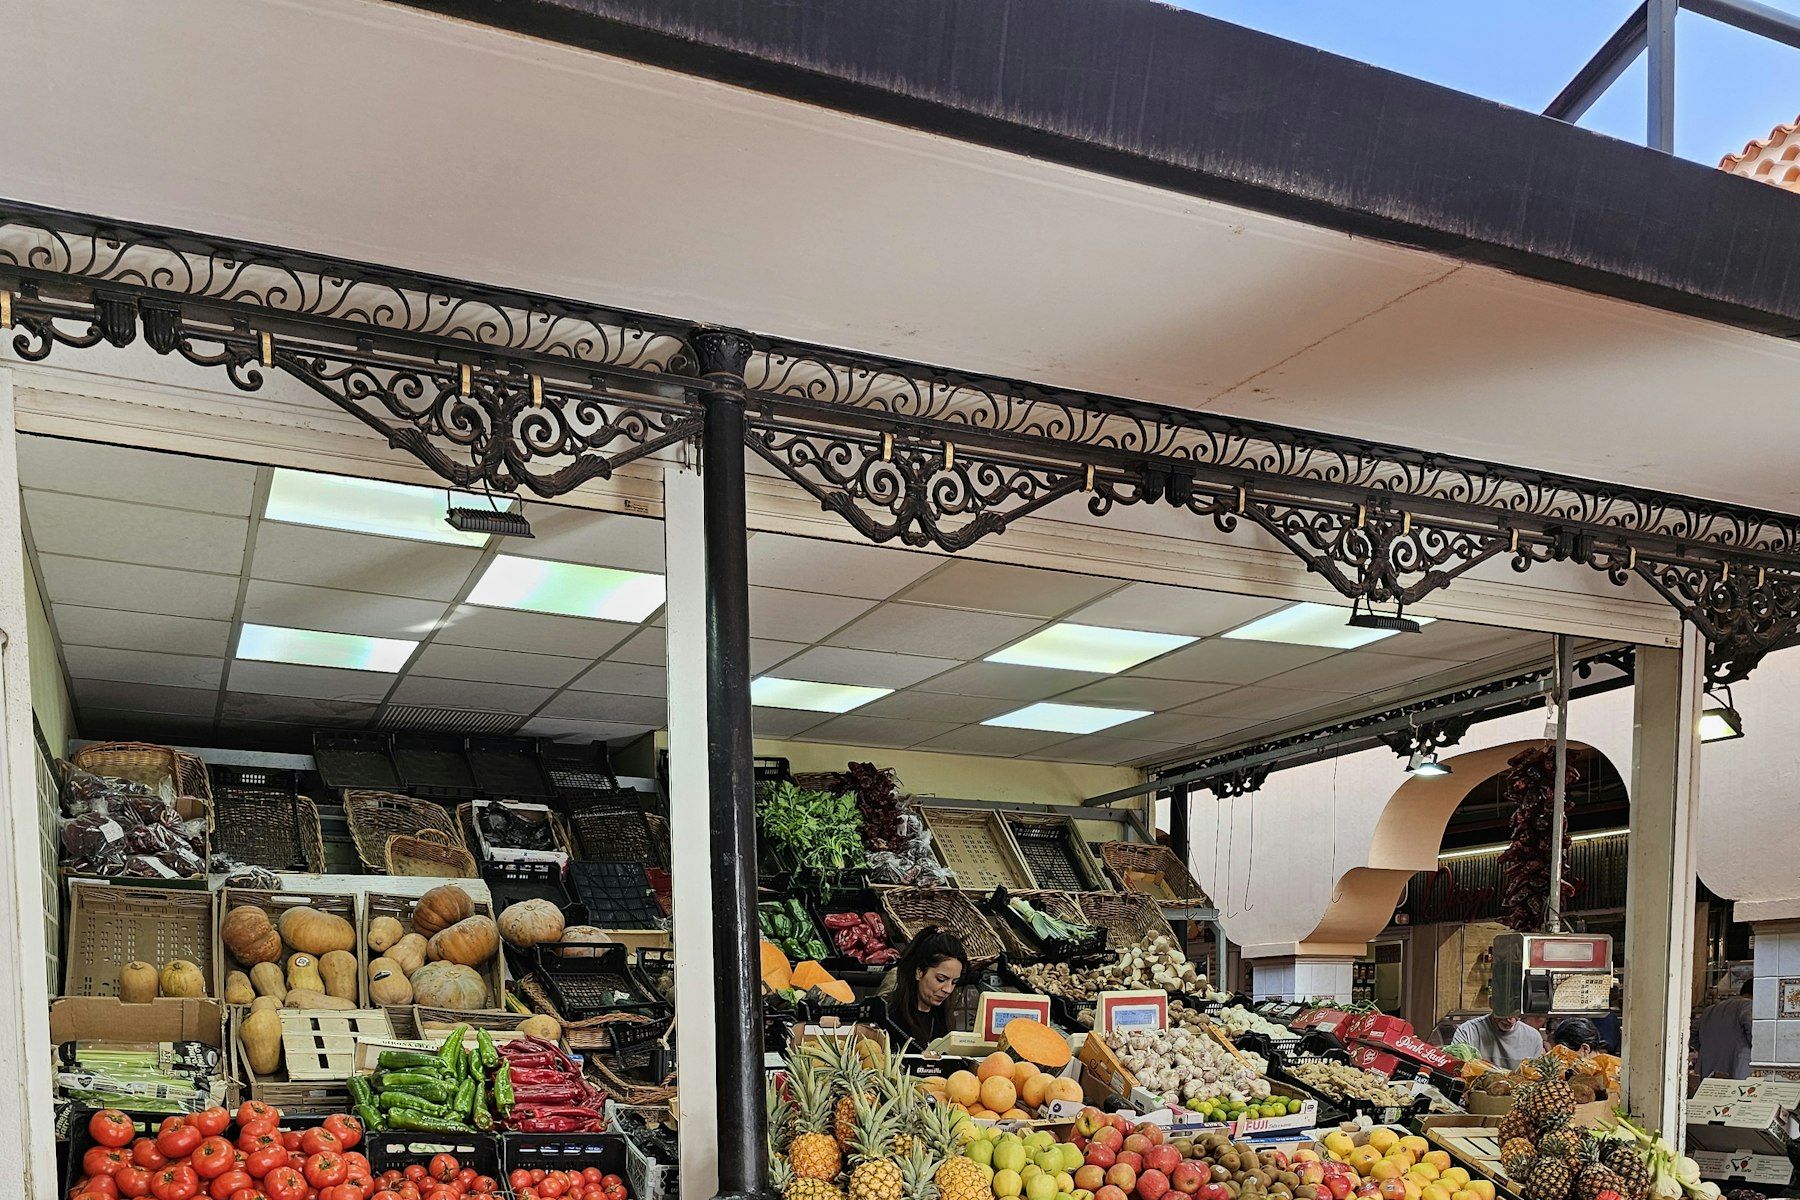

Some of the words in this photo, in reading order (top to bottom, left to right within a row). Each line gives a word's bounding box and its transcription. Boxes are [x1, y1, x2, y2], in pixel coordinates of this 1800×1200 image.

[1395, 1035, 1425, 1055] Pink
[1421, 1049, 1449, 1067] Lady
[1245, 1118, 1269, 1131] FUJI
